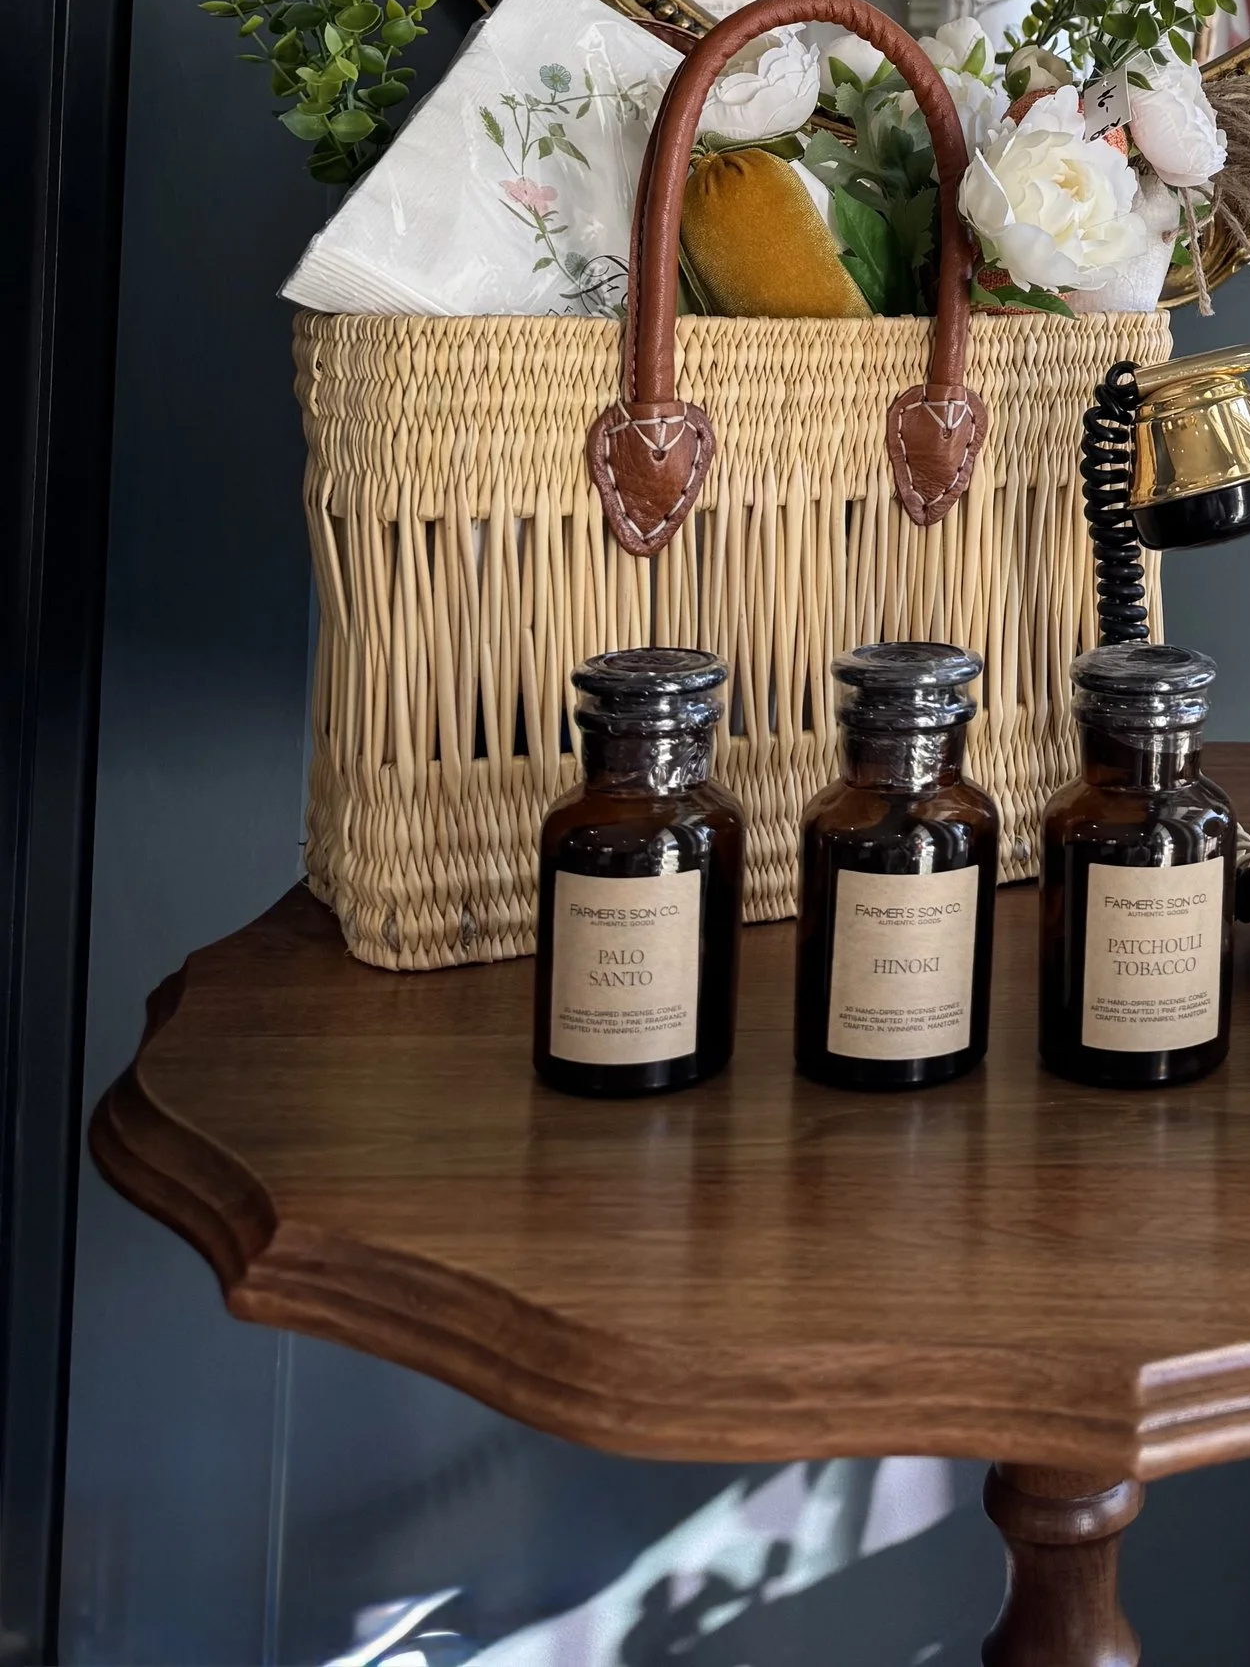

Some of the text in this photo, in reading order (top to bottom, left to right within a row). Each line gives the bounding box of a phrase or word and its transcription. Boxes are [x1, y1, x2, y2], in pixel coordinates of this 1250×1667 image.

[1104, 893, 1207, 910] FARMER'S SON CO.
[570, 903, 680, 920] FARMER'S SON CO.
[856, 902, 962, 919] FARMER'S SON CO.
[1108, 933, 1202, 955] PATCHOULI
[598, 949, 644, 965] PALO
[874, 957, 941, 974] HINOKI
[1113, 957, 1196, 976] TOBACCO
[589, 970, 653, 987] SANTO
[840, 1013, 867, 1022] ARTISAN
[928, 1009, 963, 1021] FRAGRANCE
[1091, 1005, 1119, 1014] ARTISAN
[843, 1022, 874, 1031] CRAFTED
[1095, 1014, 1126, 1023] CRAFTED
